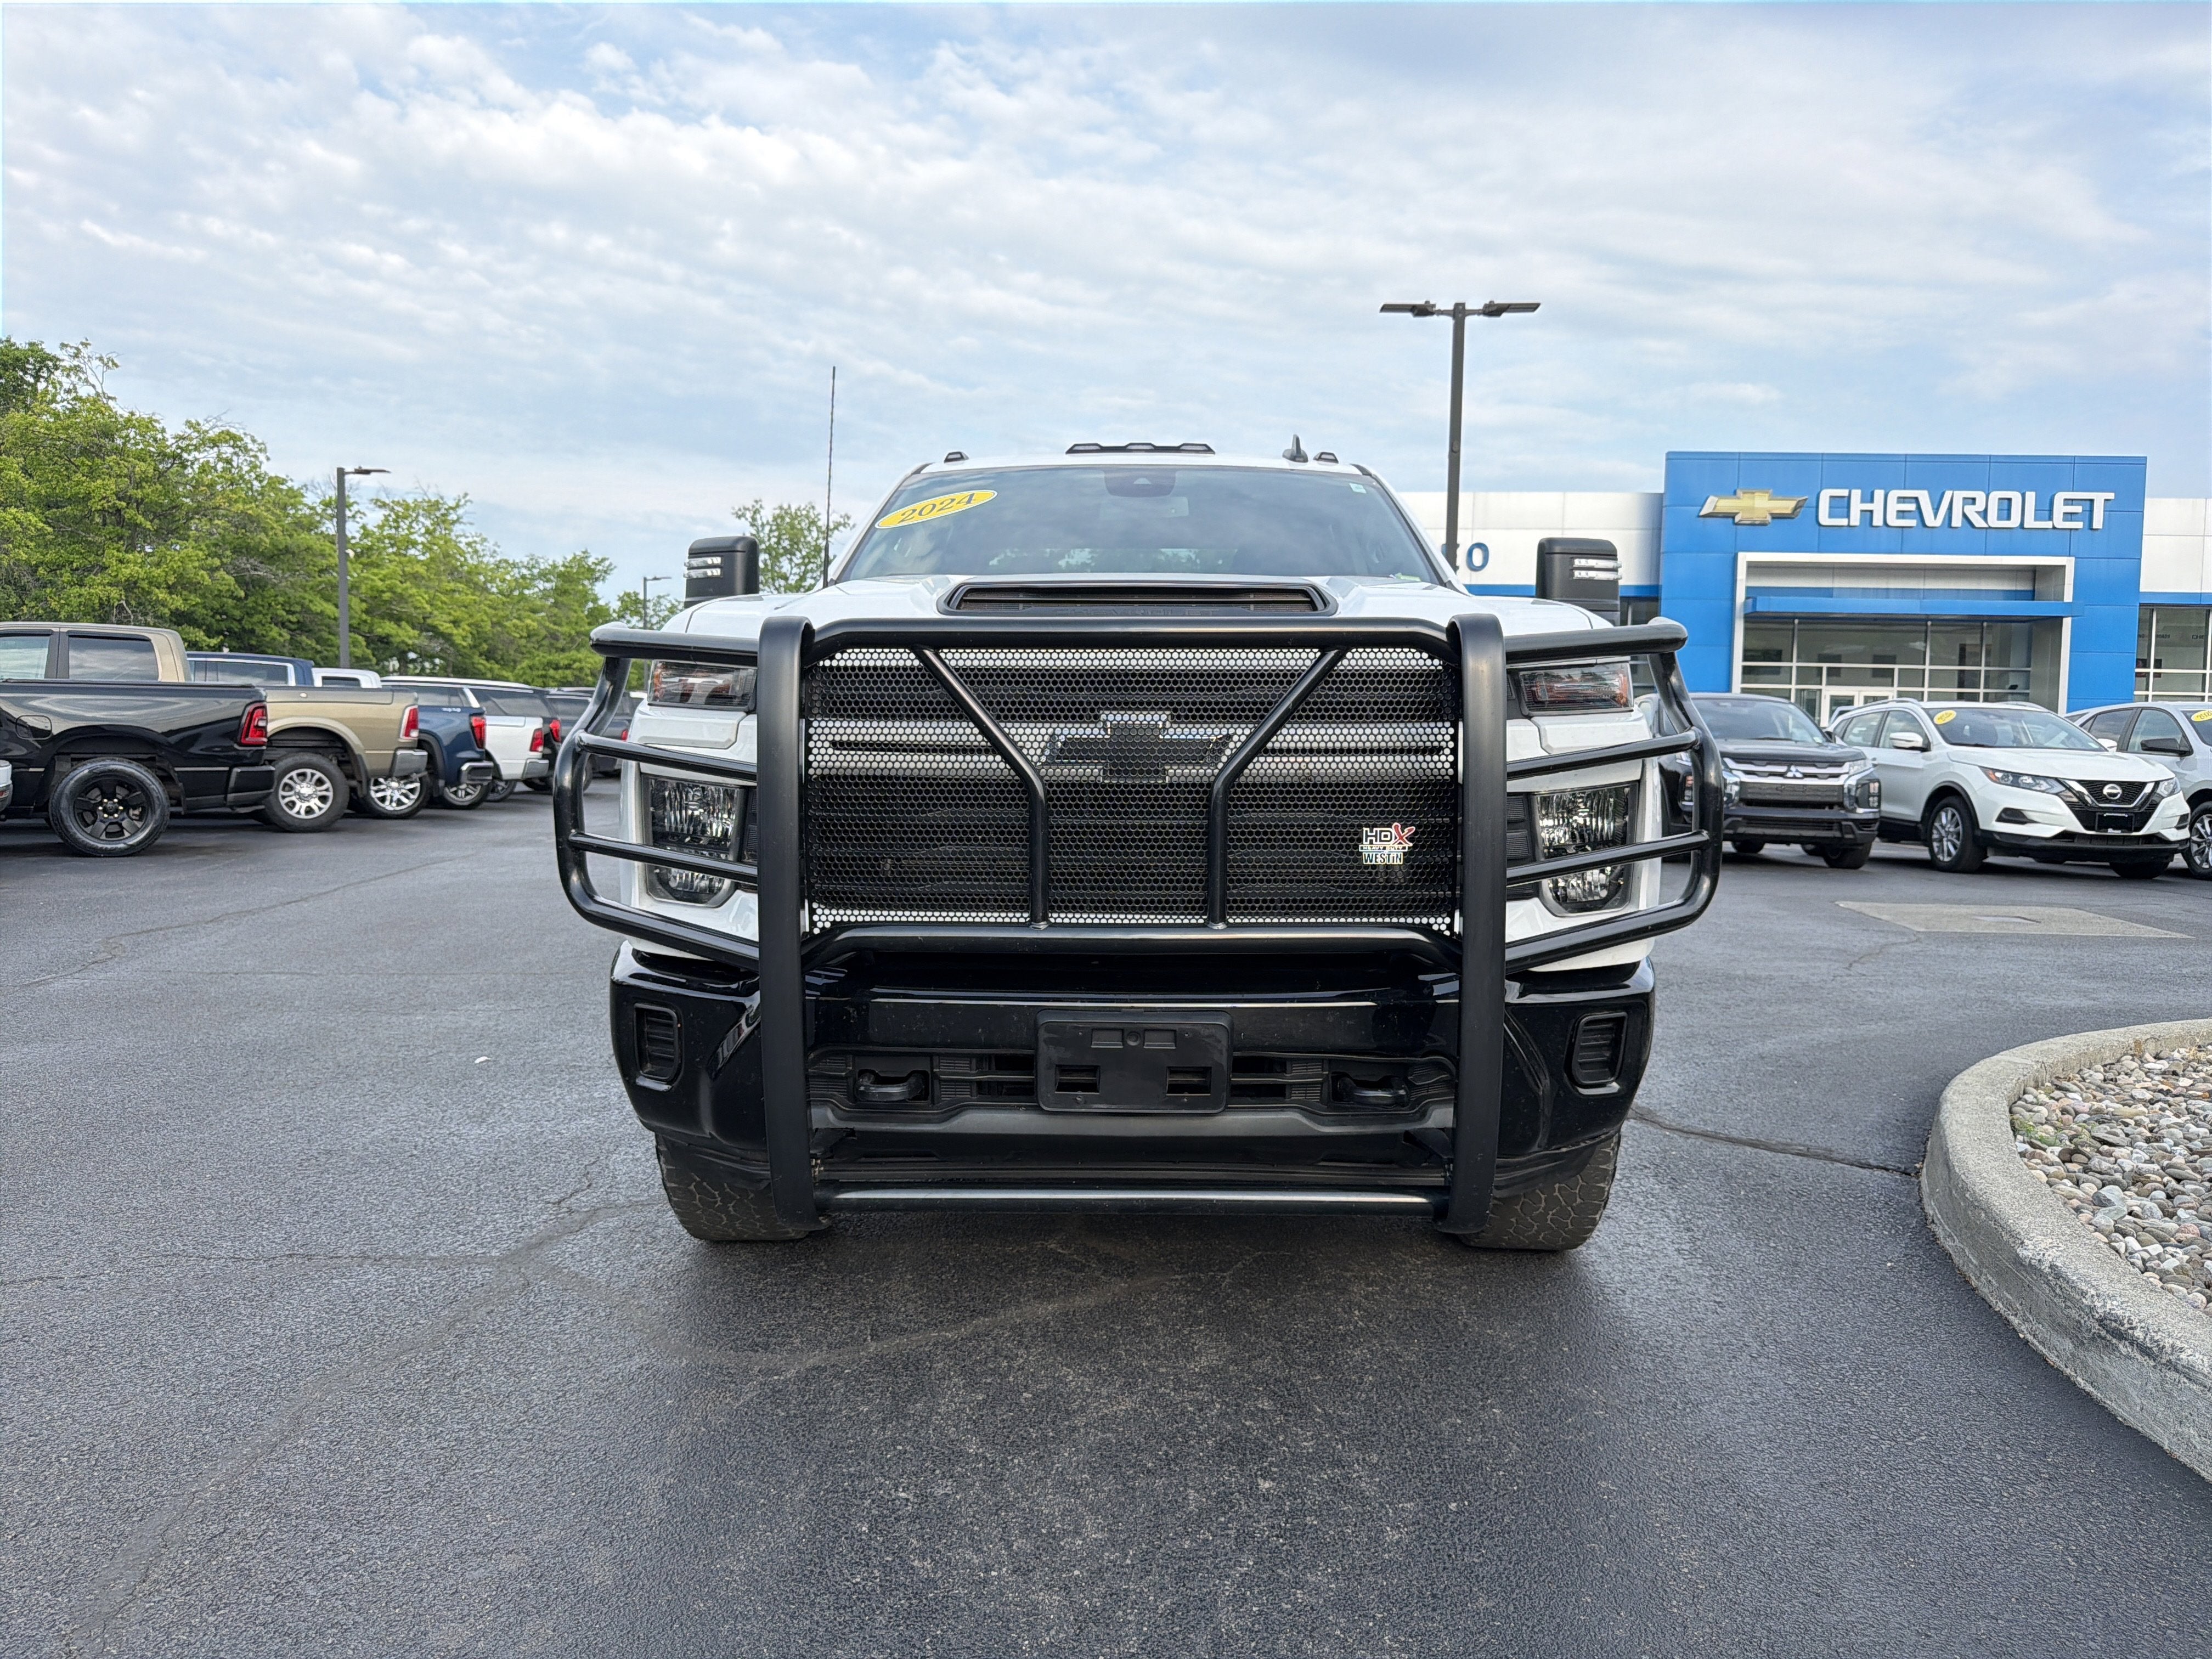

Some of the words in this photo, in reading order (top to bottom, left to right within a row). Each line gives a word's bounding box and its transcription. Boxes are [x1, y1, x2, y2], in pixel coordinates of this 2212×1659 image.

[897, 493, 976, 524] 2024
[1818, 488, 2115, 529] CHEVROLET
[1363, 822, 1416, 847] HDX
